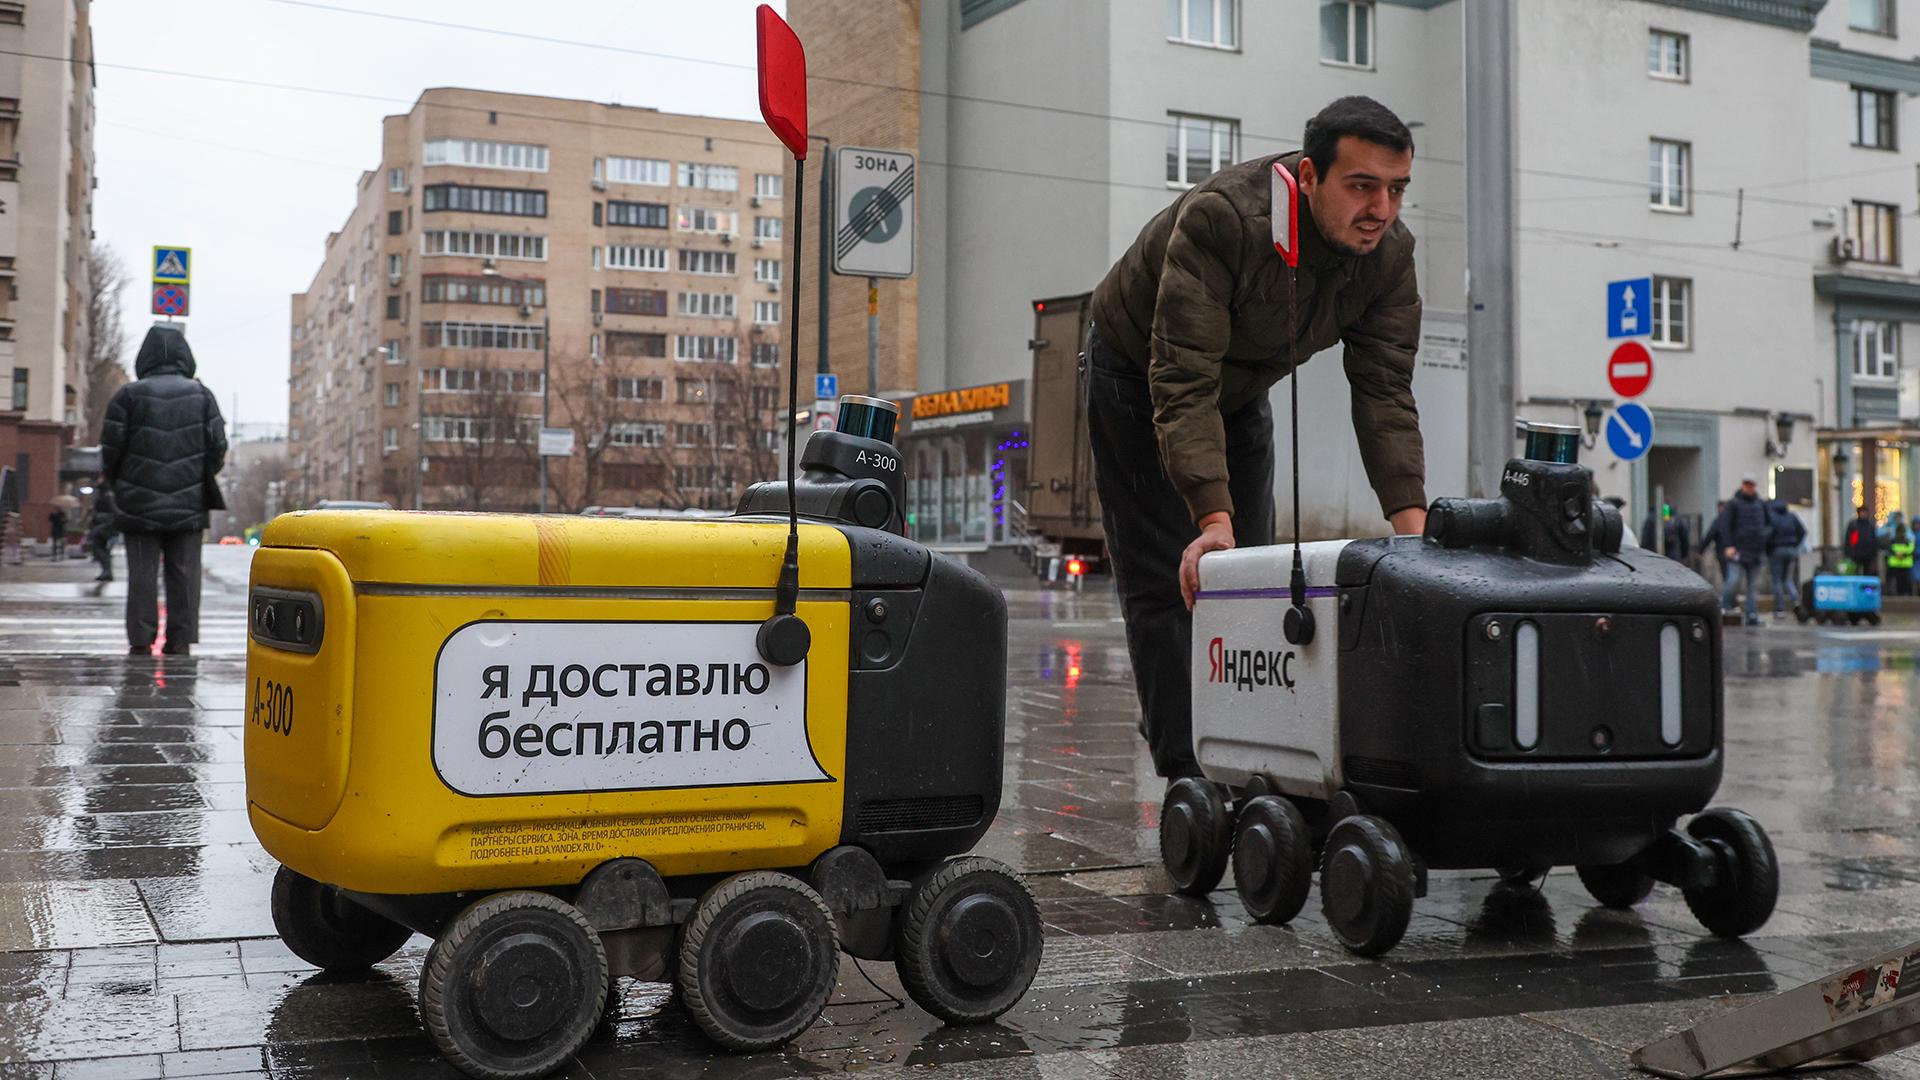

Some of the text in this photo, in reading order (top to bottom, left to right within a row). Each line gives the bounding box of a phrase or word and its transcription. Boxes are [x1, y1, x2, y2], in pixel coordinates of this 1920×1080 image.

[855, 155, 898, 173] ЗОНА
[1209, 637, 1295, 692] Яндекс
[480, 662, 770, 707] я доставлю
[478, 710, 751, 759] бесплатно
[471, 823, 504, 835] ЯНДЕКС
[505, 823, 523, 834] ЕДА
[649, 814, 689, 826] ДОСТАВКУ
[582, 829, 608, 841] ВРЕМЯ
[609, 826, 651, 839] ДОСТАВКИ
[652, 826, 658, 835] И
[658, 824, 716, 836] ПРЕДЛОЖЕНИЯ
[470, 847, 522, 860] ПОДРОБНЕЕ
[522, 847, 534, 856] НА
